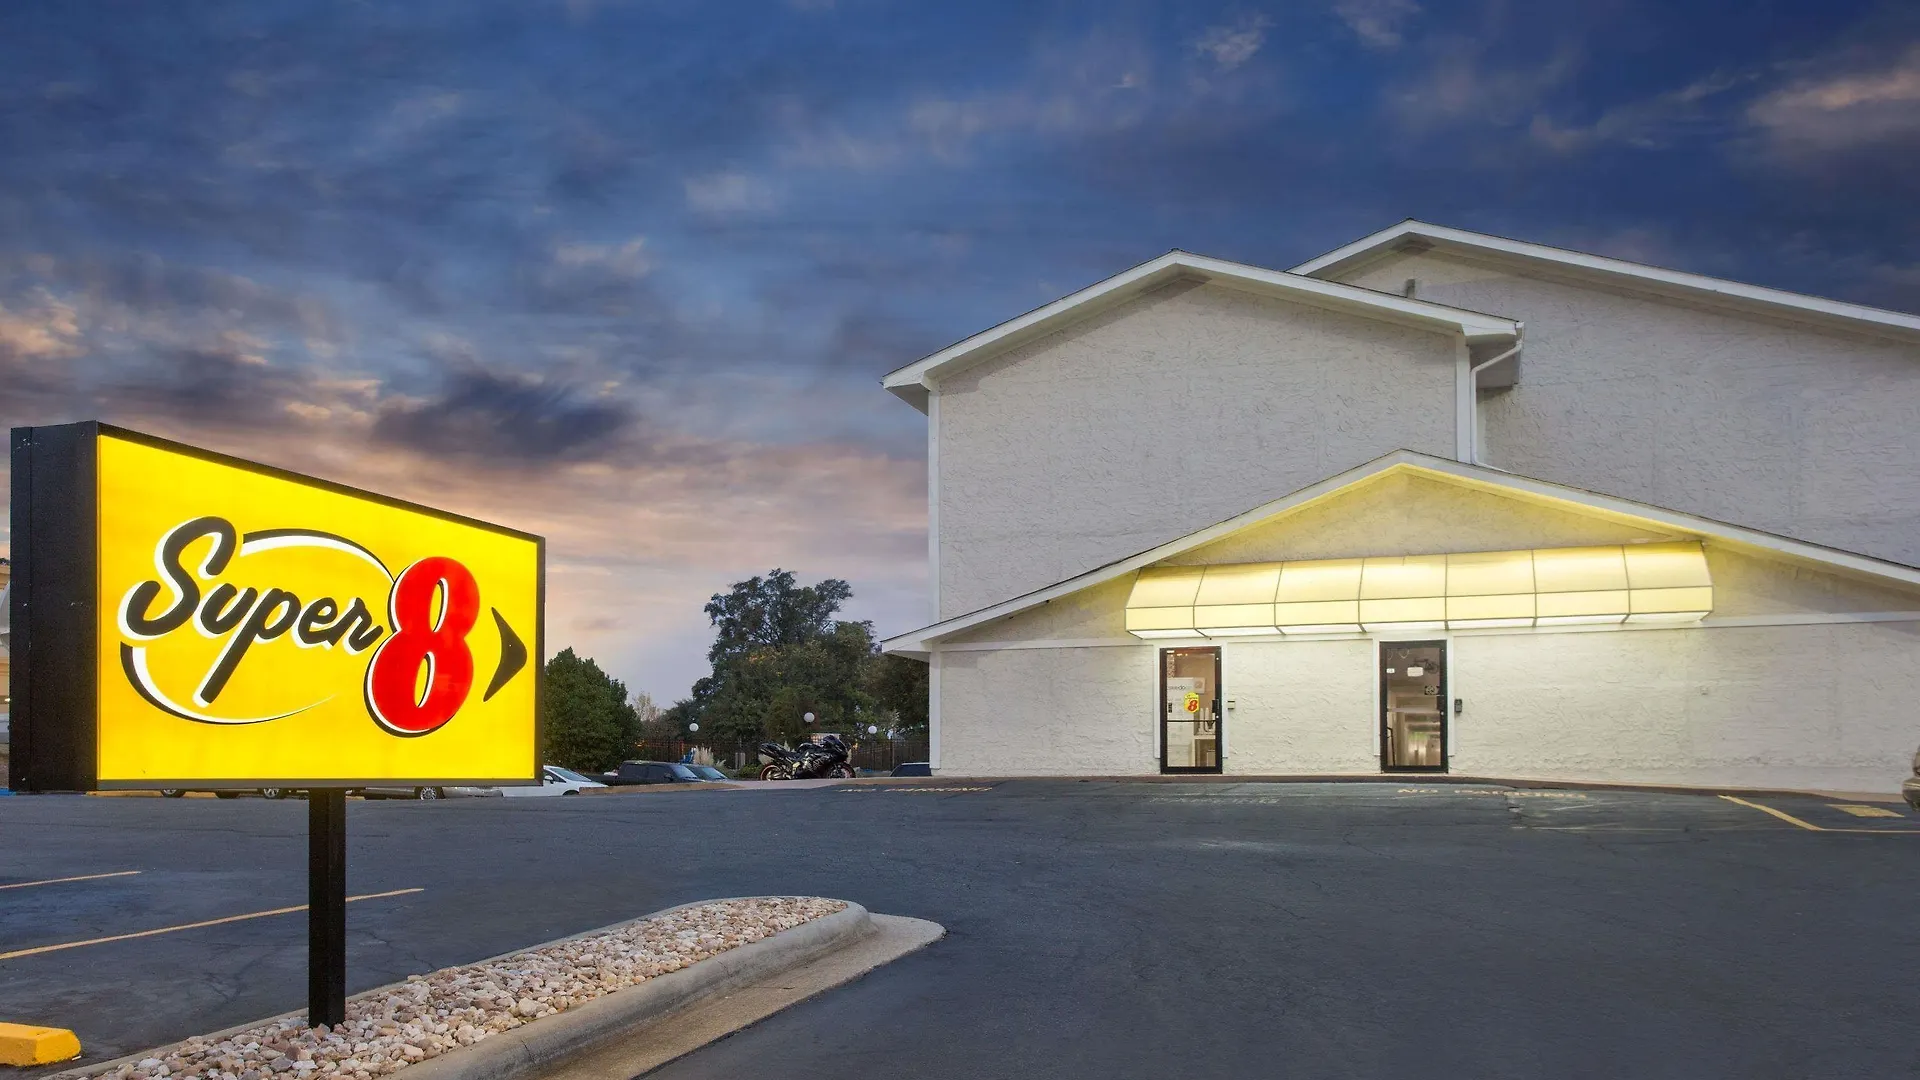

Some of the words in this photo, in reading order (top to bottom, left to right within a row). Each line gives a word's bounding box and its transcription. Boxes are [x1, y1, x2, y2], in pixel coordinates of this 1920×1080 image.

[119, 515, 384, 708] Super
[363, 556, 481, 739] 8
[1187, 699, 1198, 712] 8
